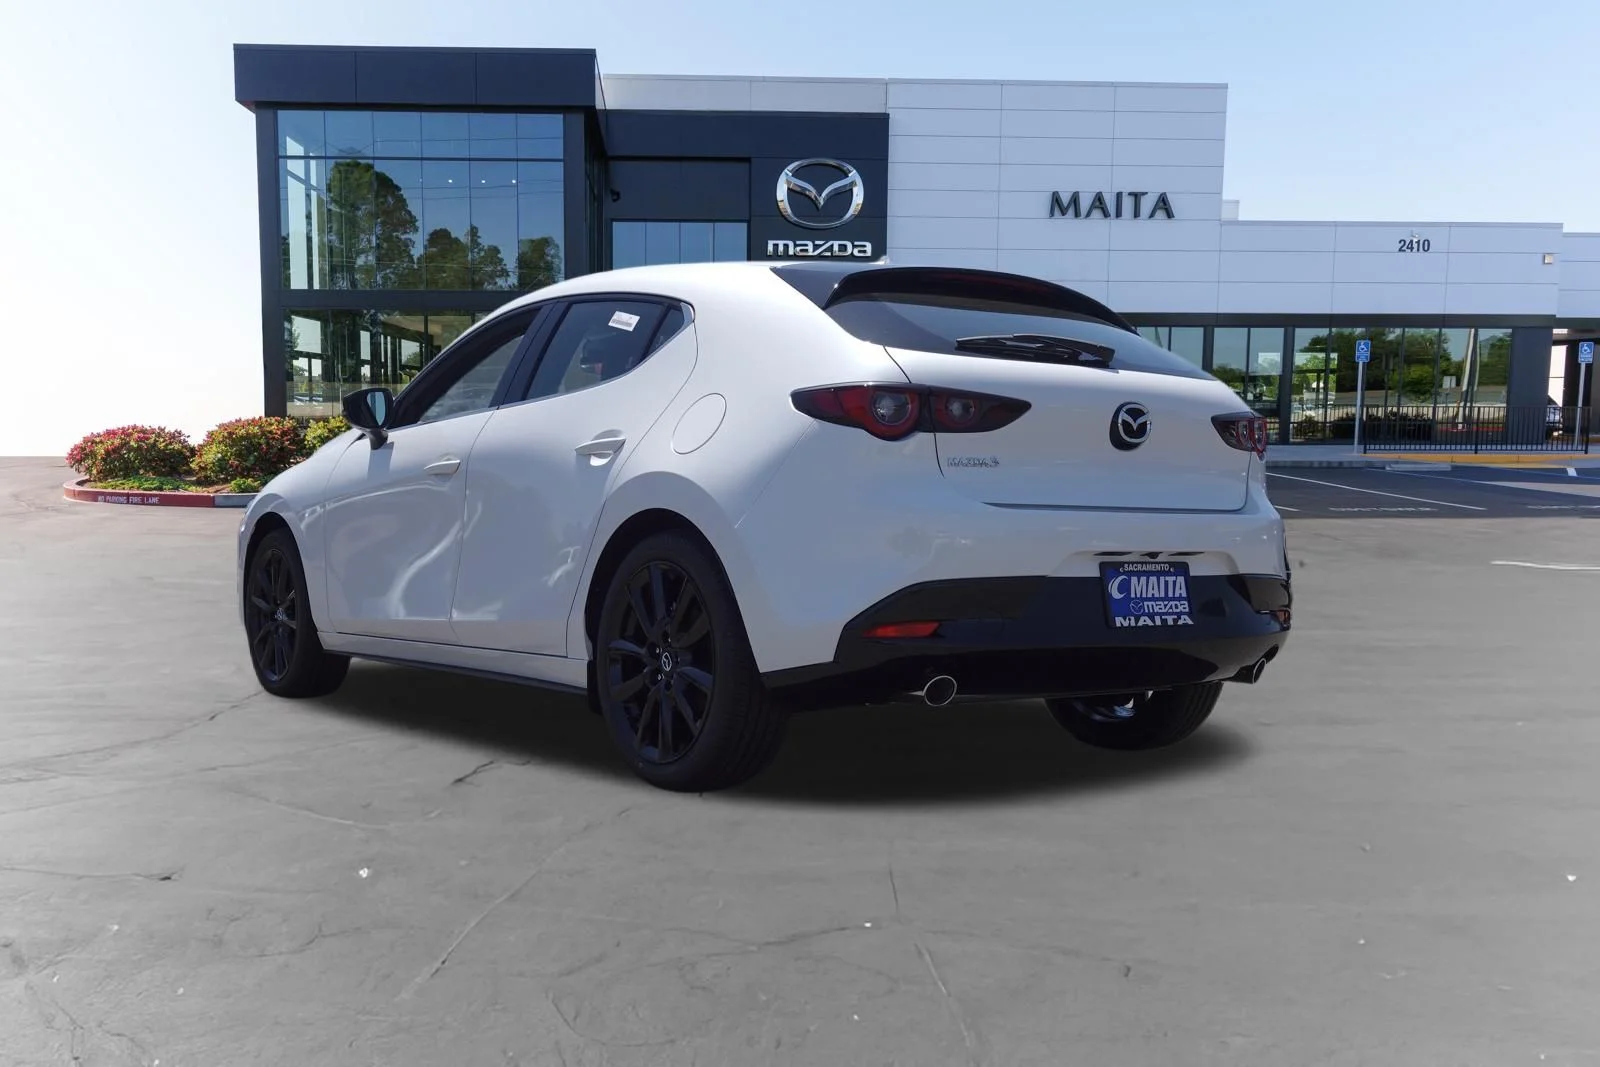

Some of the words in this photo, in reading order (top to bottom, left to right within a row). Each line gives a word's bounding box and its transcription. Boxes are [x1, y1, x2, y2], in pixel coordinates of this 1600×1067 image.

[1049, 190, 1175, 219] MAITA
[767, 239, 872, 257] mazda
[1398, 238, 1431, 253] 2410
[129, 496, 143, 504] FIRE
[144, 496, 160, 504] LANE
[1123, 563, 1170, 572] SACRAMENTO
[1130, 575, 1188, 599] MAITA
[1143, 600, 1190, 613] mazda
[1114, 615, 1195, 628] MAITA
